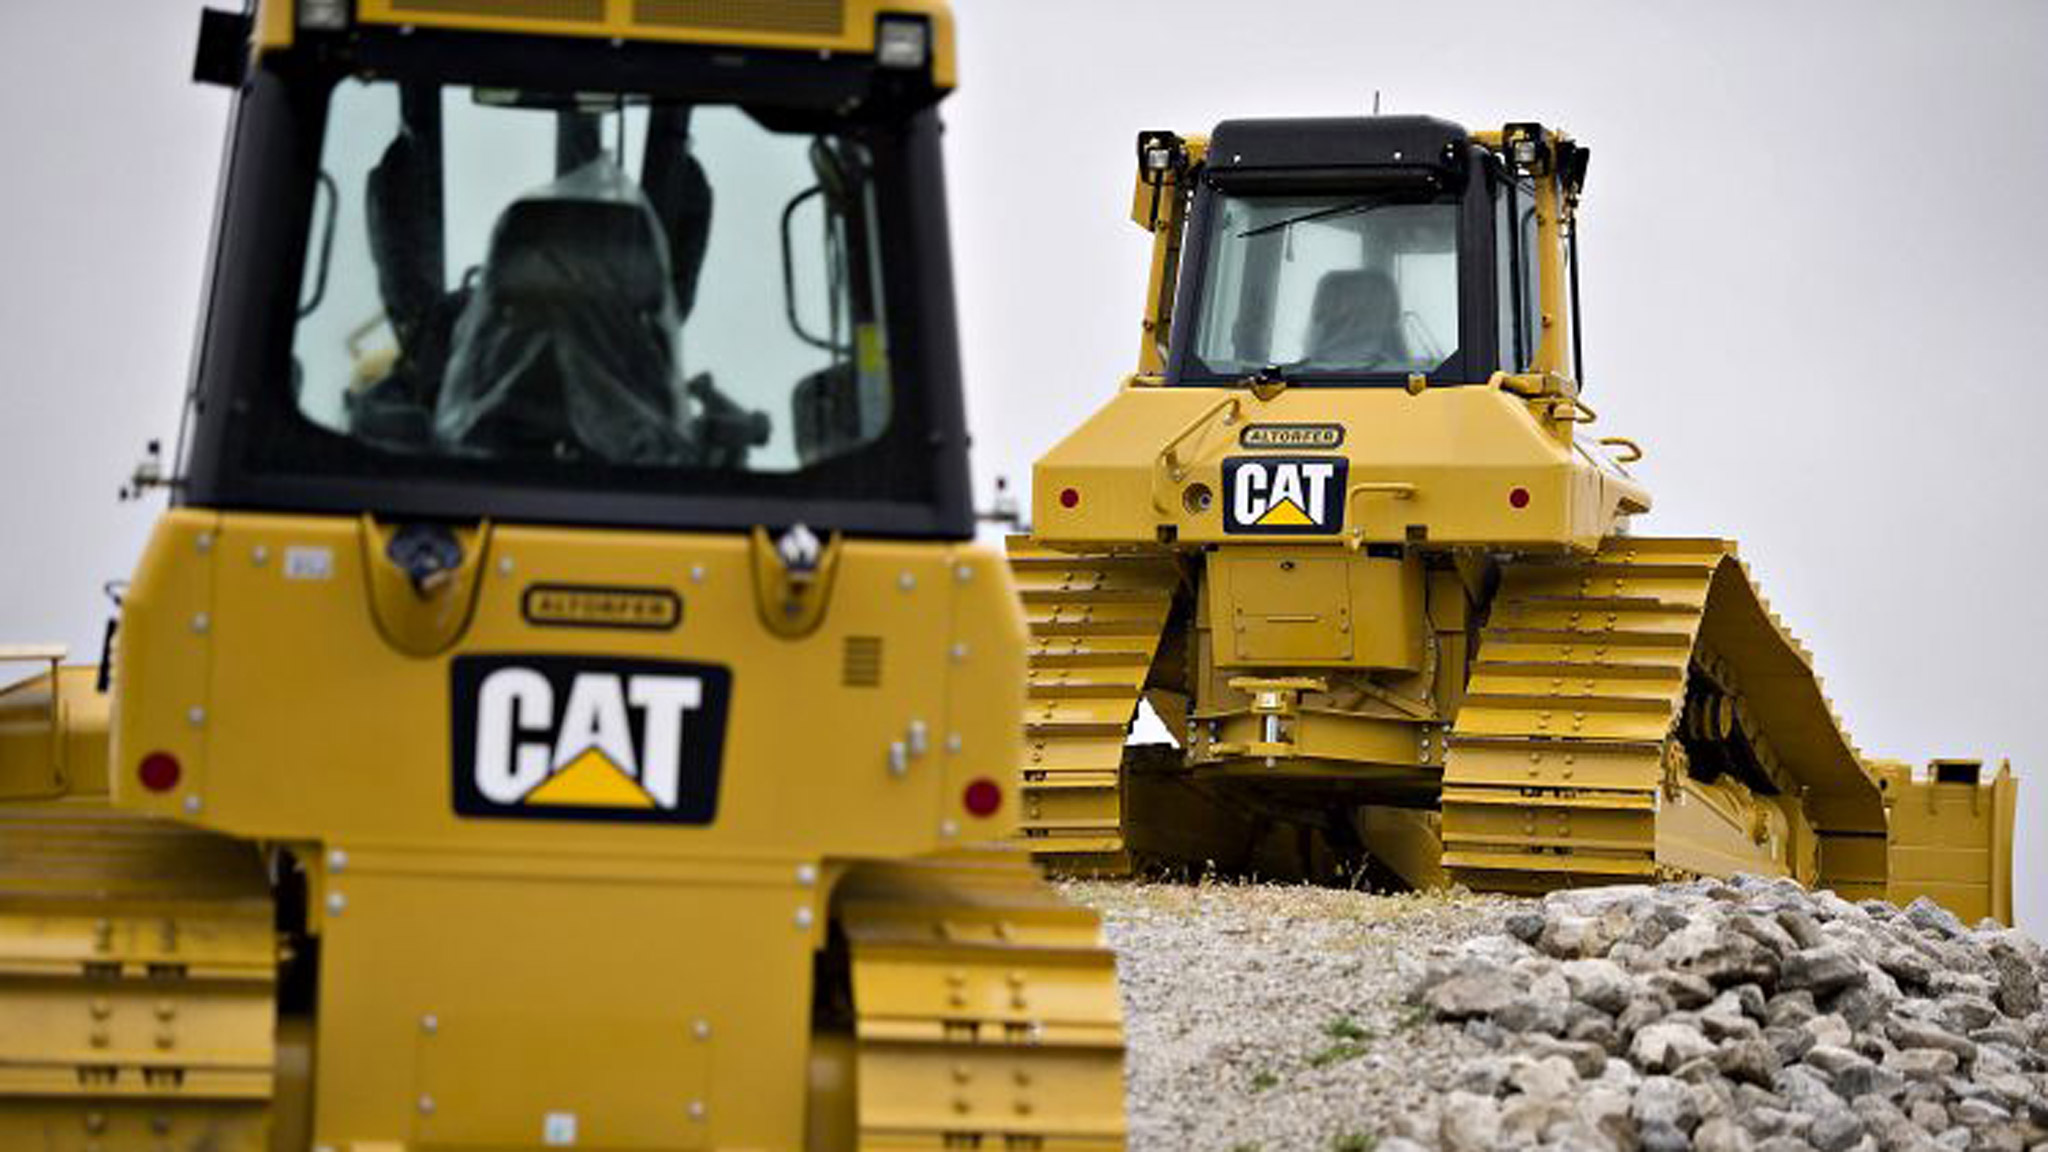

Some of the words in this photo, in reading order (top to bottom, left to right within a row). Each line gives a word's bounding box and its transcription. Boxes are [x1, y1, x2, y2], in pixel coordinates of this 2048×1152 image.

[1250, 429, 1334, 442] ALTORFER
[1234, 463, 1334, 525] CAT
[475, 667, 702, 809] CAT
